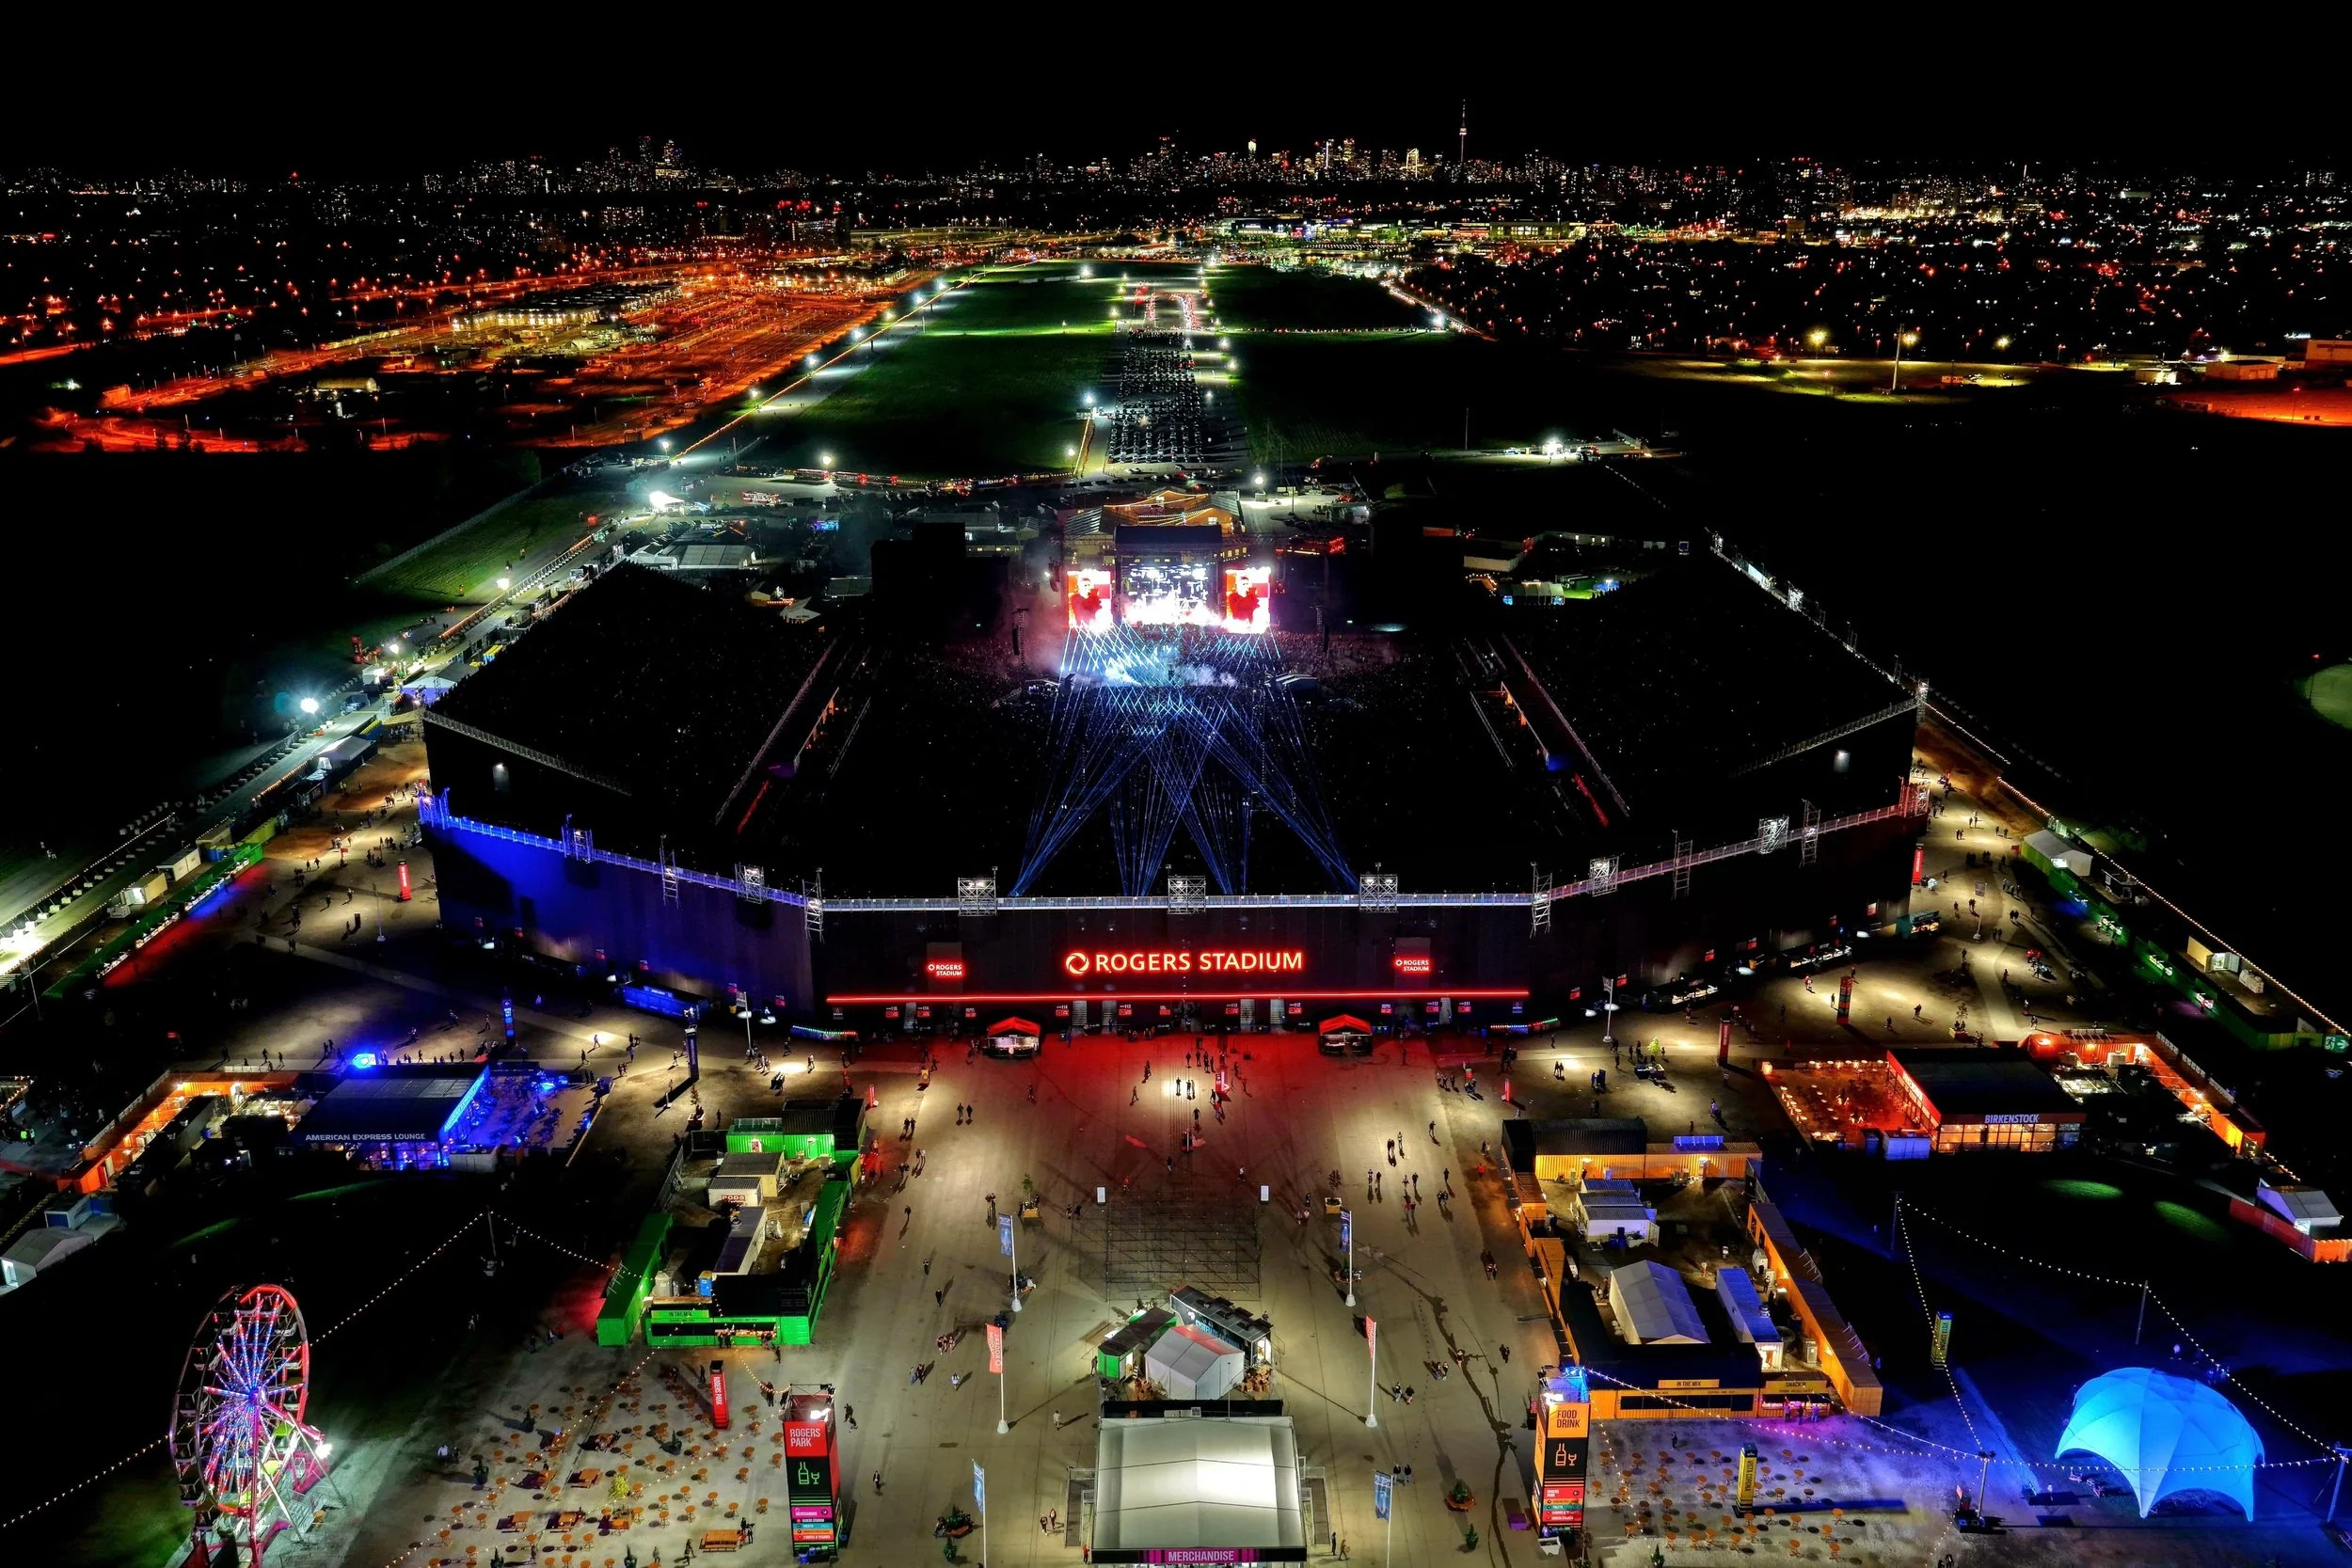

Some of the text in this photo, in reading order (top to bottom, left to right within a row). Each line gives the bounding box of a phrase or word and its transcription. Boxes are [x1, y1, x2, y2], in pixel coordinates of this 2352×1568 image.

[1095, 952, 1302, 972] ROGERS STADIUM
[1984, 1114, 2040, 1124] BIRKENSTOCK
[713, 1376, 723, 1405] ROGERS PARK
[1557, 1409, 1577, 1419] FOOD
[1556, 1418, 1581, 1428] DRINK
[789, 1428, 820, 1438] ROGERS
[790, 1437, 812, 1448] PARK
[1744, 1473, 1753, 1492] CORONA
[1168, 1550, 1234, 1561] MERCHANDISE
